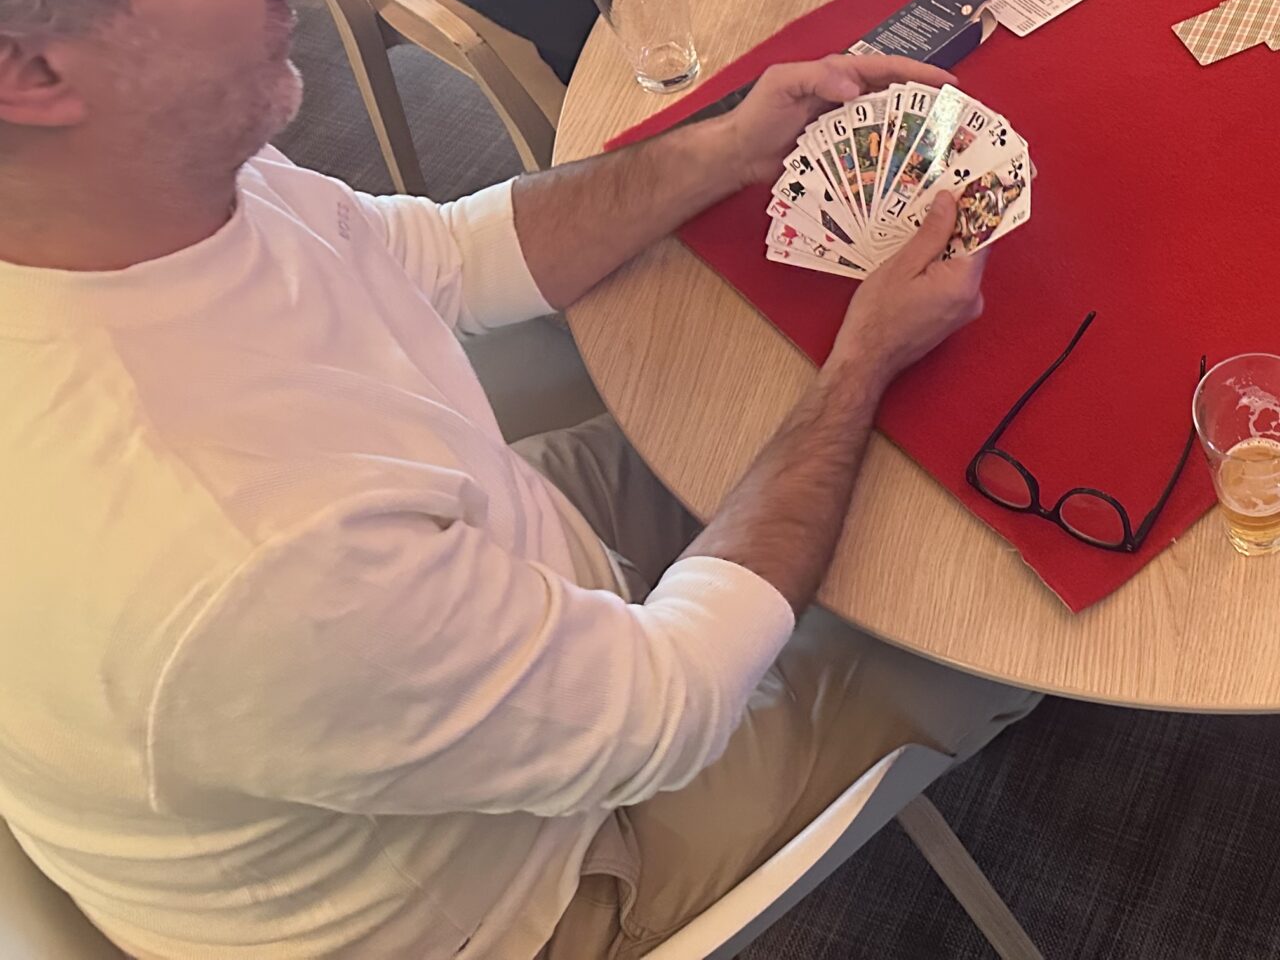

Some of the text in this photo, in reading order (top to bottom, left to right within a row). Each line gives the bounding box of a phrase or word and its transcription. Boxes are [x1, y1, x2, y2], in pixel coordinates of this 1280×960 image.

[910, 92, 926, 112] 14
[855, 105, 867, 122] 9
[966, 111, 986, 131] 19
[833, 120, 847, 136] 6
[789, 158, 801, 171] 10
